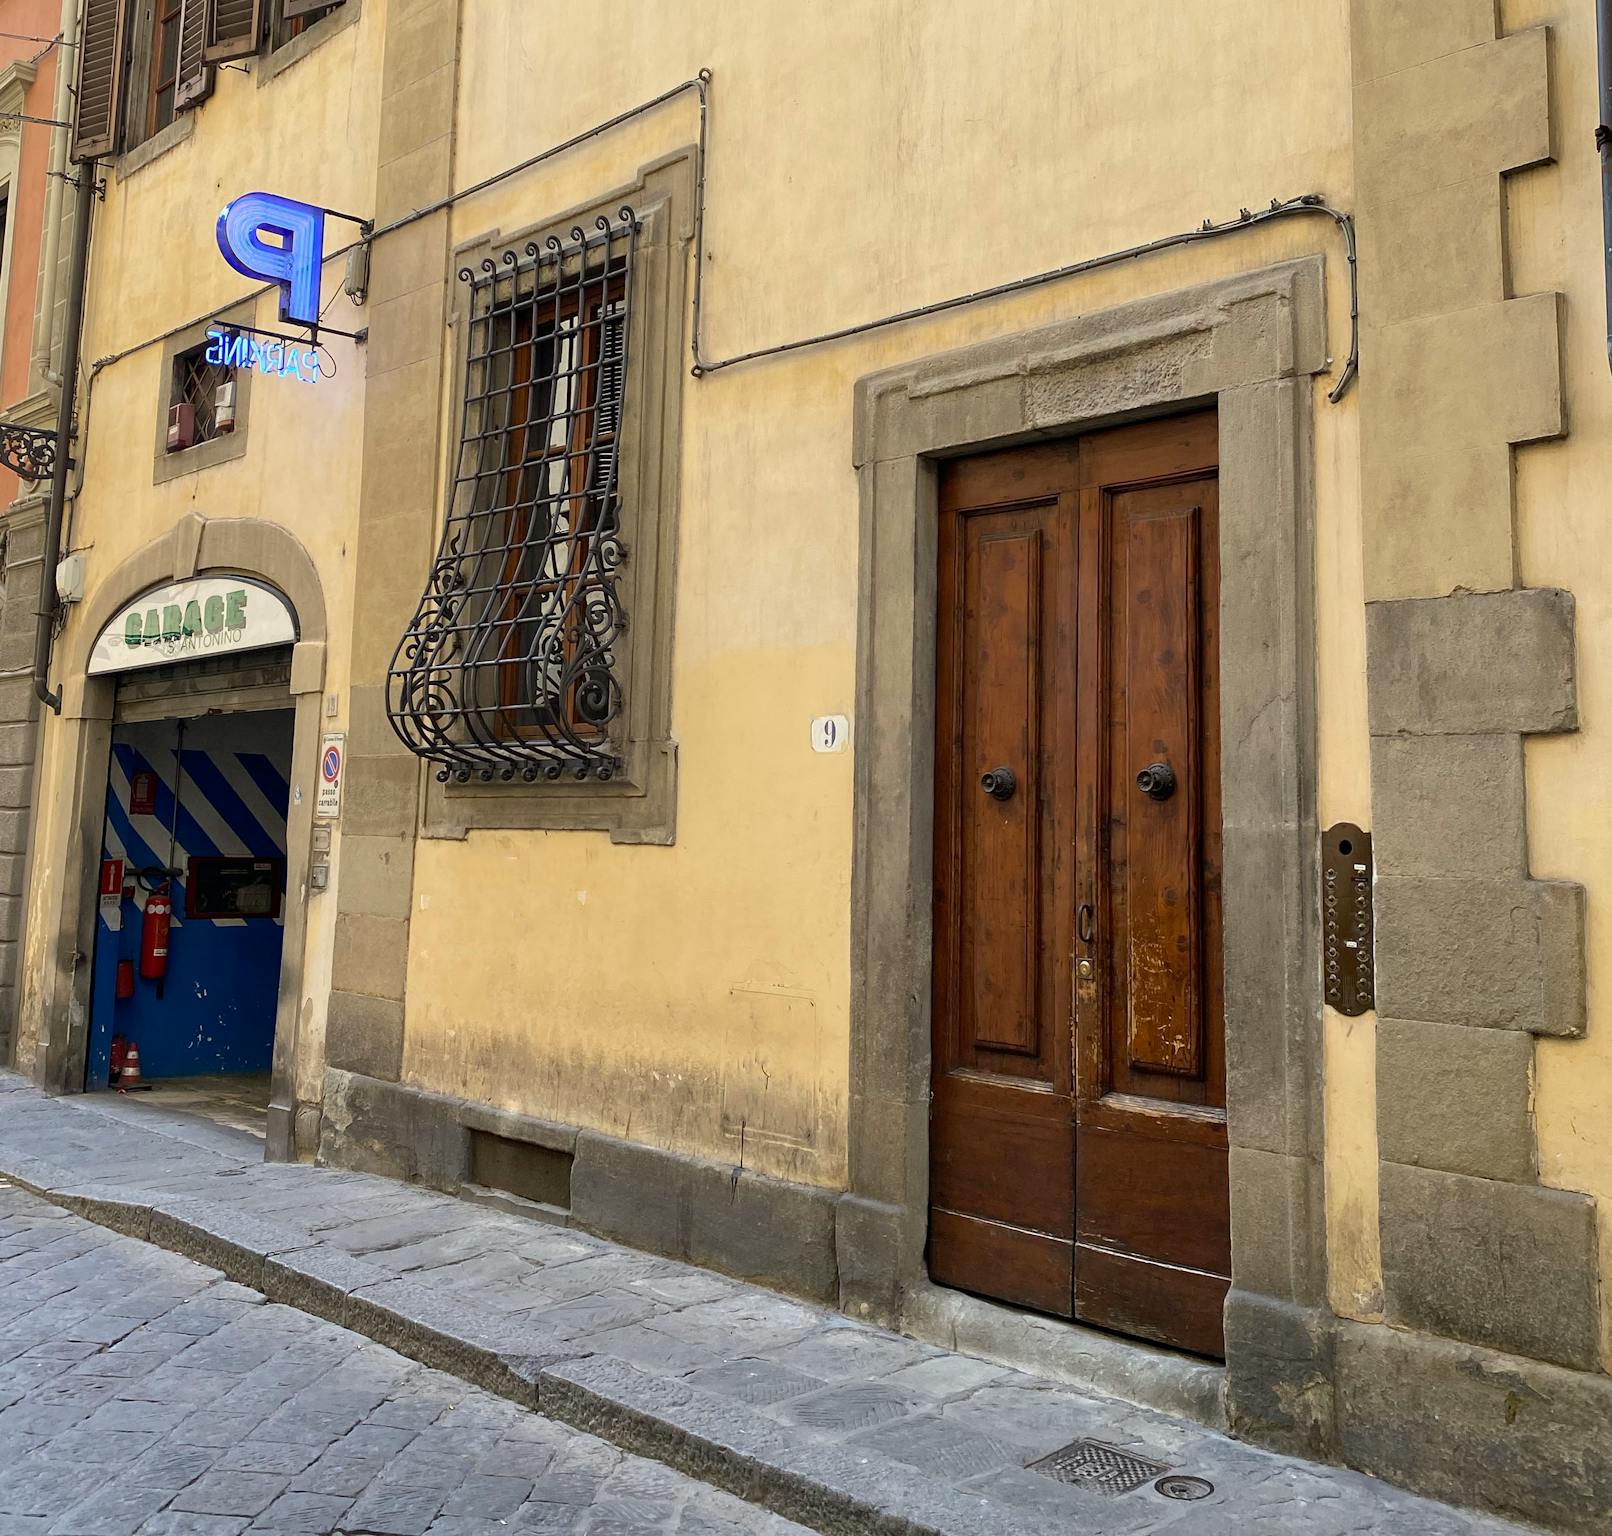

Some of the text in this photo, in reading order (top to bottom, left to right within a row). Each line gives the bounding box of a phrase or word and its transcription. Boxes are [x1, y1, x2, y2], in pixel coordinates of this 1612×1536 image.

[125, 590, 247, 649] GARAGE
[181, 628, 242, 652] ANTONINO
[824, 719, 836, 748] 9
